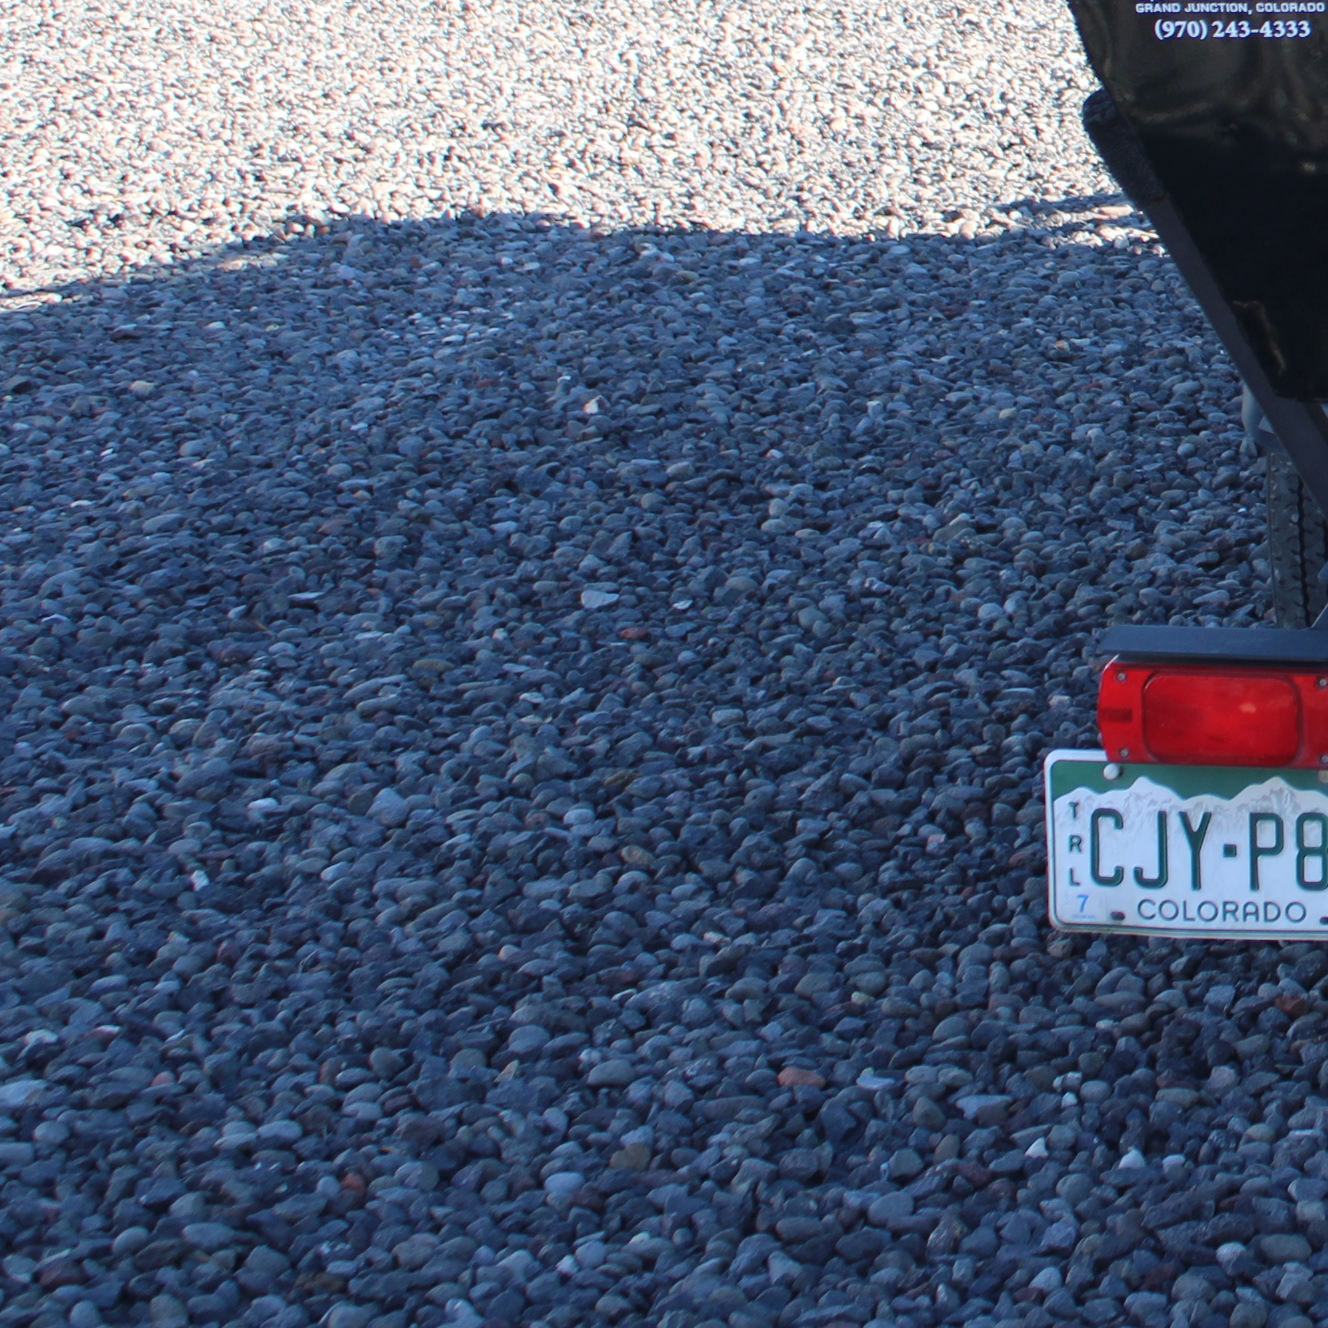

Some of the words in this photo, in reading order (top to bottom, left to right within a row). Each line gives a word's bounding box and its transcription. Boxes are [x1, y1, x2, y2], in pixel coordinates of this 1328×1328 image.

[1135, 2, 1181, 13] GRAND
[1184, 2, 1253, 15] JUNCTION,
[1255, 2, 1326, 13] COLORADO
[1154, 19, 1208, 41] (970)
[1211, 20, 1312, 39] 243-4333
[1076, 894, 1089, 913] 7
[1136, 899, 1308, 924] COLORADO
